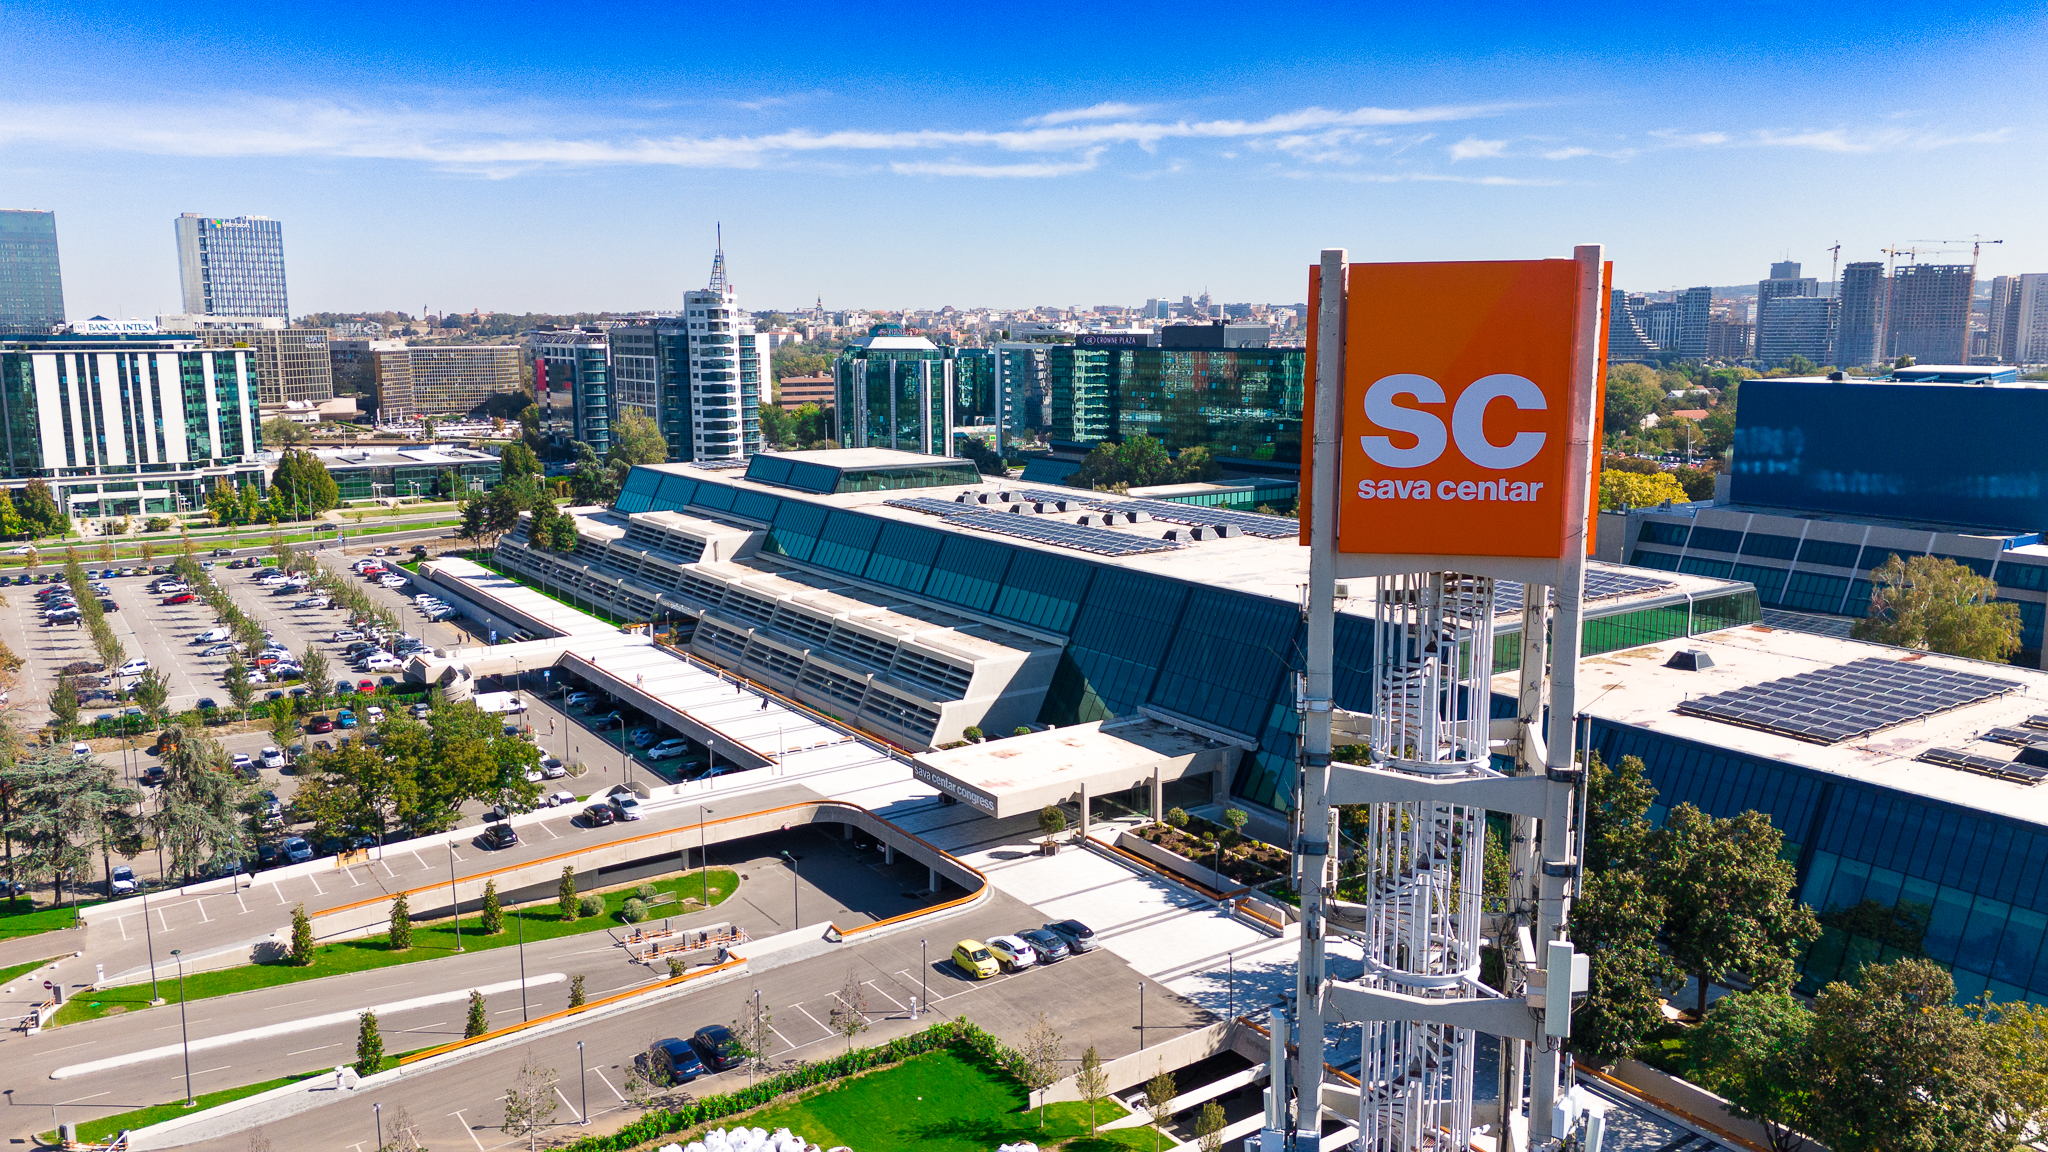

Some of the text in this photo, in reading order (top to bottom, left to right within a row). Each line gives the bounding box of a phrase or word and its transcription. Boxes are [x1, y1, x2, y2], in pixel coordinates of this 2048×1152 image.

[222, 221, 251, 229] Microsoft
[88, 323, 154, 331] BANCA INTESA
[1096, 336, 1136, 345] CROWNE PLAZA
[1360, 373, 1548, 470] SC
[1357, 478, 1544, 502] sava centar
[914, 765, 995, 811] sava centar congress
